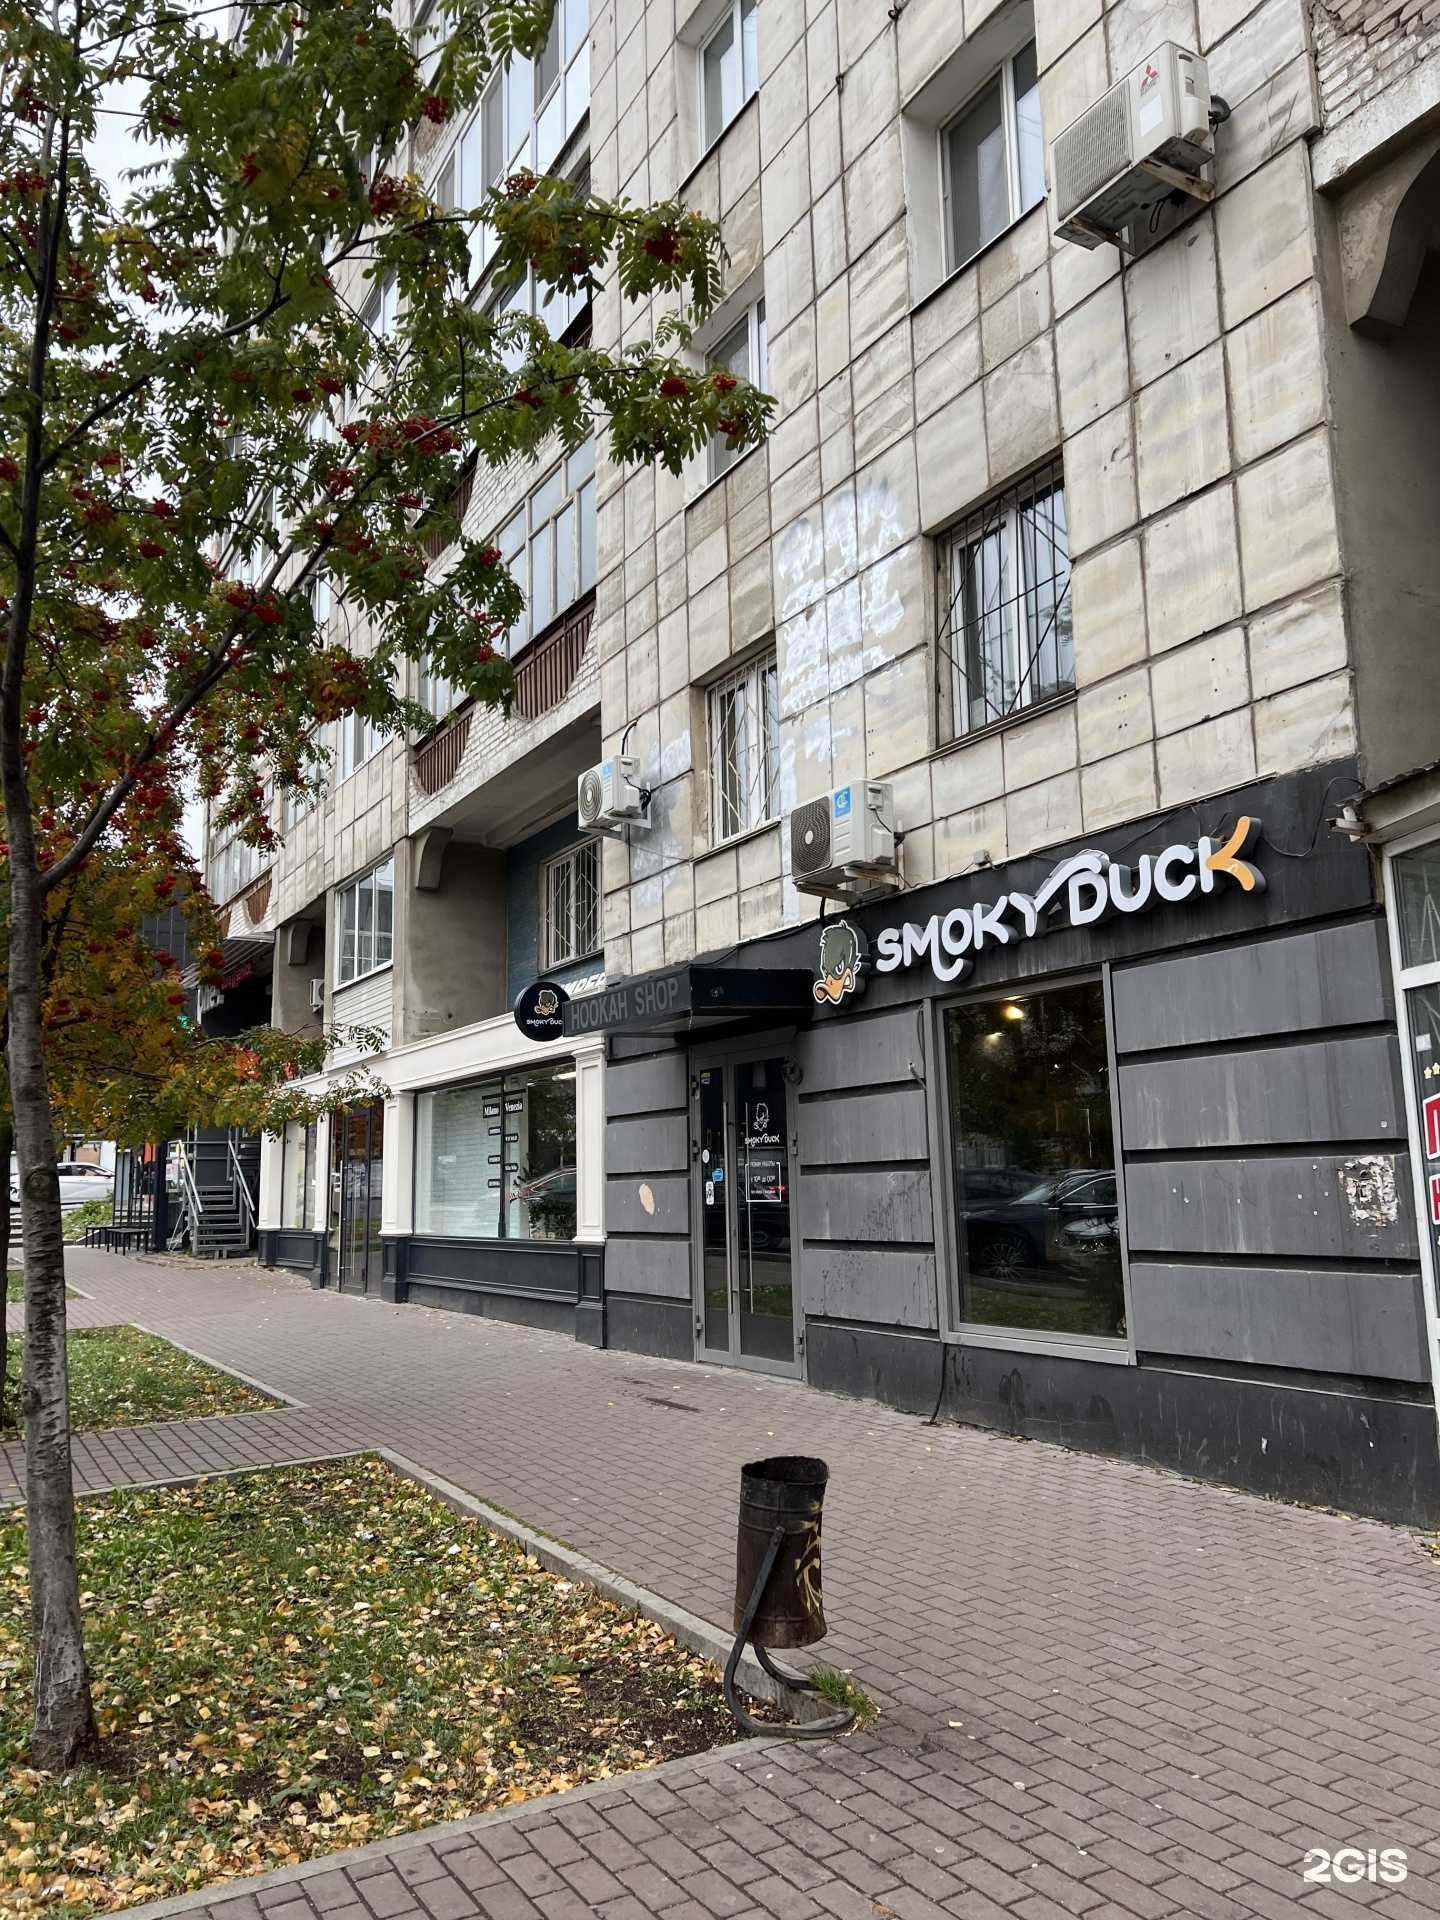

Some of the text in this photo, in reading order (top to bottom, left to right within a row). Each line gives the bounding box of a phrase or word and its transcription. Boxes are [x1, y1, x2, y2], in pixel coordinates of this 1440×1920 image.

[876, 816, 1256, 981] SMOKY DUCK
[526, 1018, 553, 1027] SMOKY
[571, 978, 679, 1030] HOOKAH SHOP
